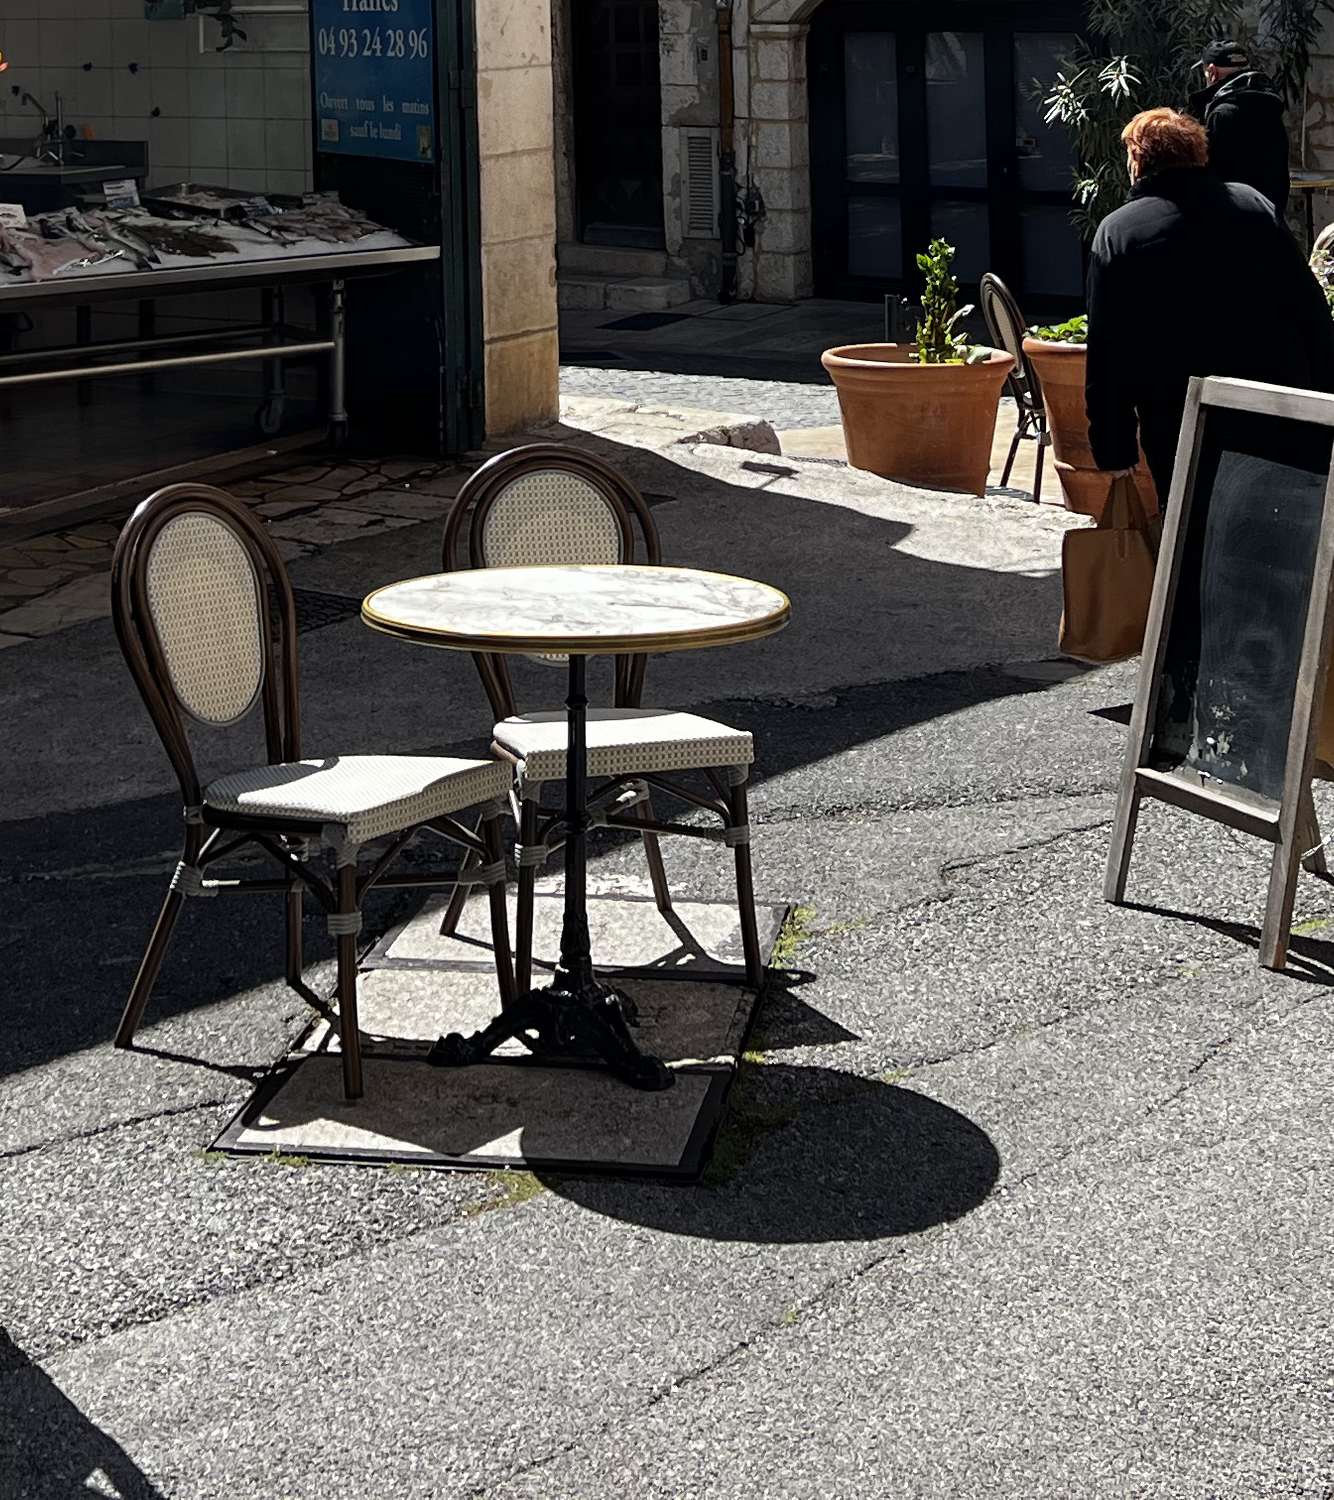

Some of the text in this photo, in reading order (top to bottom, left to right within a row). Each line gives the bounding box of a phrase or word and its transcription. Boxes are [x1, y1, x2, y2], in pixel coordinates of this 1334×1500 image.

[319, 26, 428, 59] 04 93 24 28 96
[356, 98, 375, 112] tous
[382, 95, 395, 112] les
